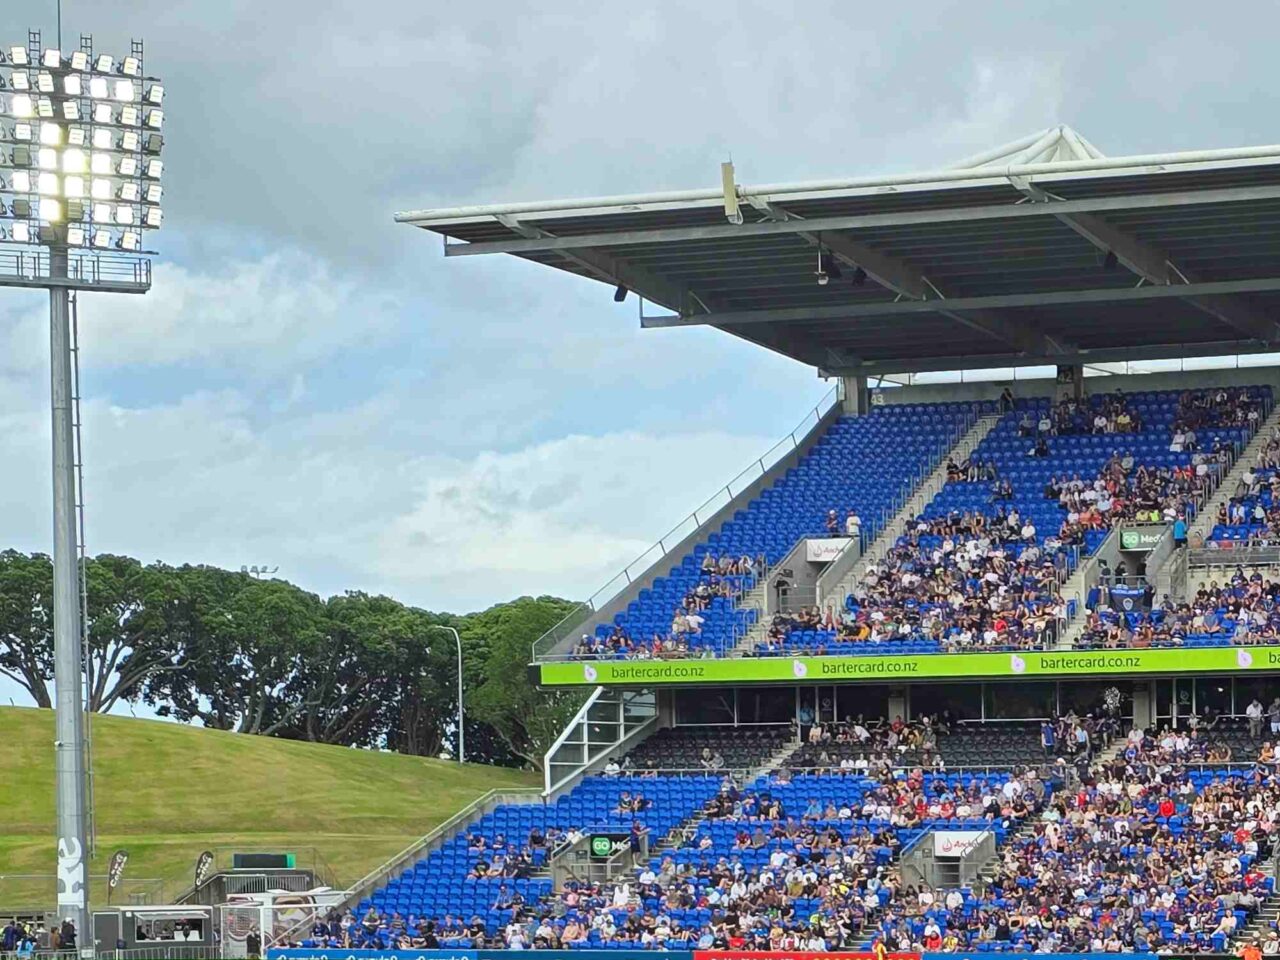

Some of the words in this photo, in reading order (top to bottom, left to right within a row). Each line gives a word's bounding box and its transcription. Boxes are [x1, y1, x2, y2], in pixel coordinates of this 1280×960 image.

[821, 659, 918, 675] bartercard.co.nz
[1040, 653, 1141, 670] bartercard.co.nz
[611, 664, 704, 679] bartercard.co.nz
[594, 841, 609, 850] GO
